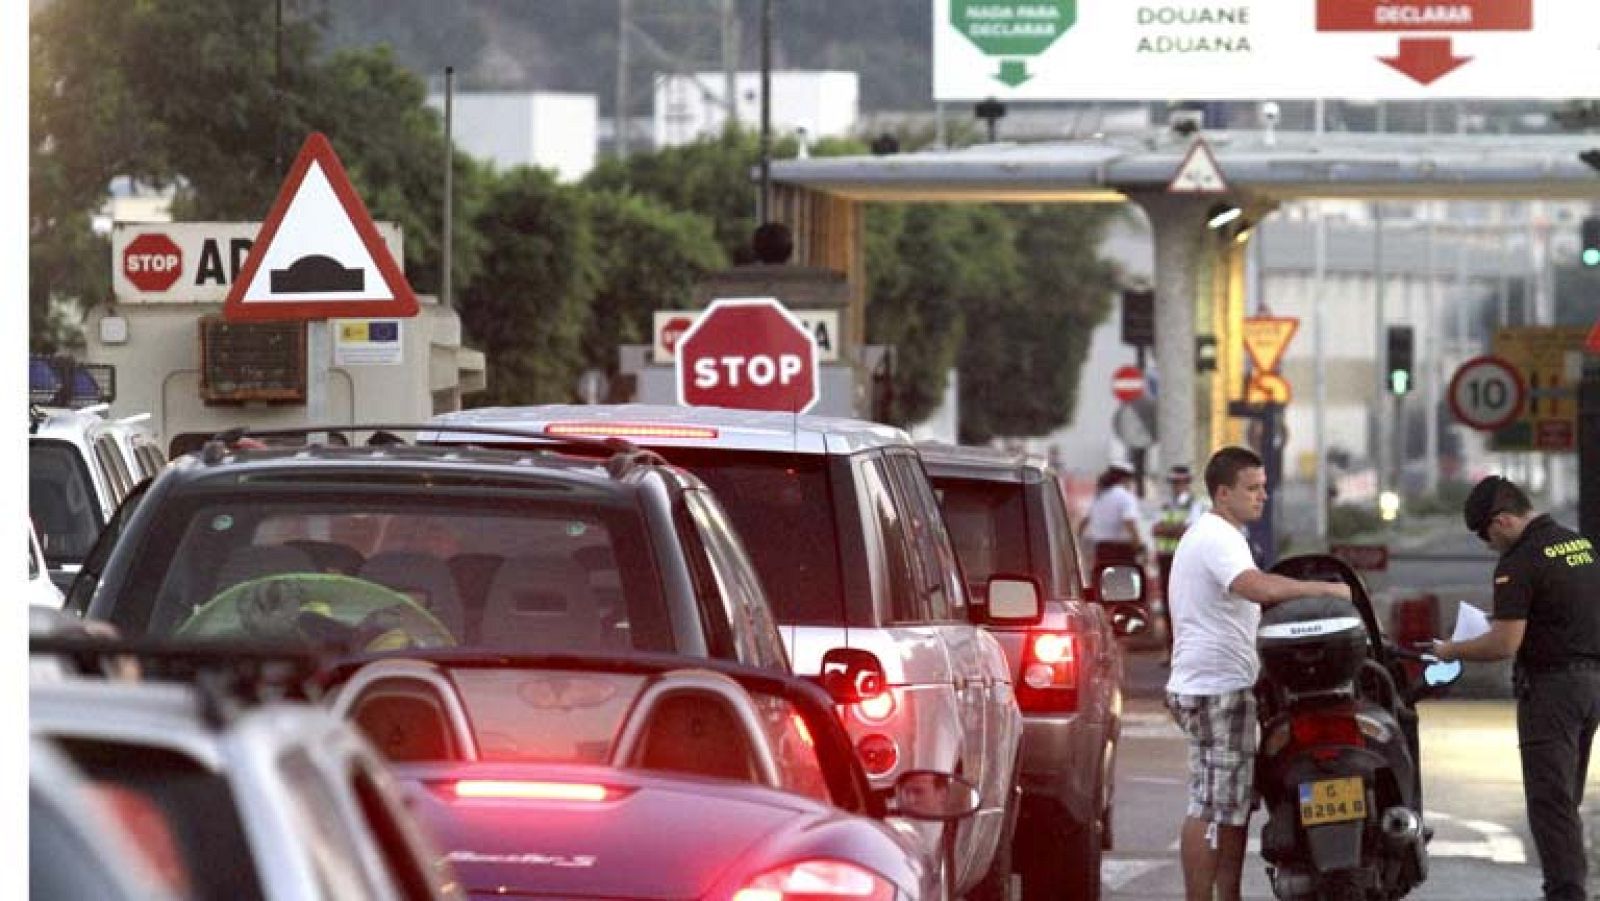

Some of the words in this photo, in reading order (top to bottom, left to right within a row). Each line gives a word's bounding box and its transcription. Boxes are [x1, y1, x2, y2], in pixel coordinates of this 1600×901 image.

[966, 4, 1013, 18] NADA
[1015, 5, 1059, 18] PARA
[1137, 6, 1251, 25] DOUANE
[1374, 5, 1473, 24] DECLARAR
[968, 22, 1056, 36] DECLARAR
[1136, 36, 1252, 53] ADUANA
[126, 253, 179, 273] STOP
[693, 353, 802, 389] STOP
[1467, 378, 1507, 410] 10
